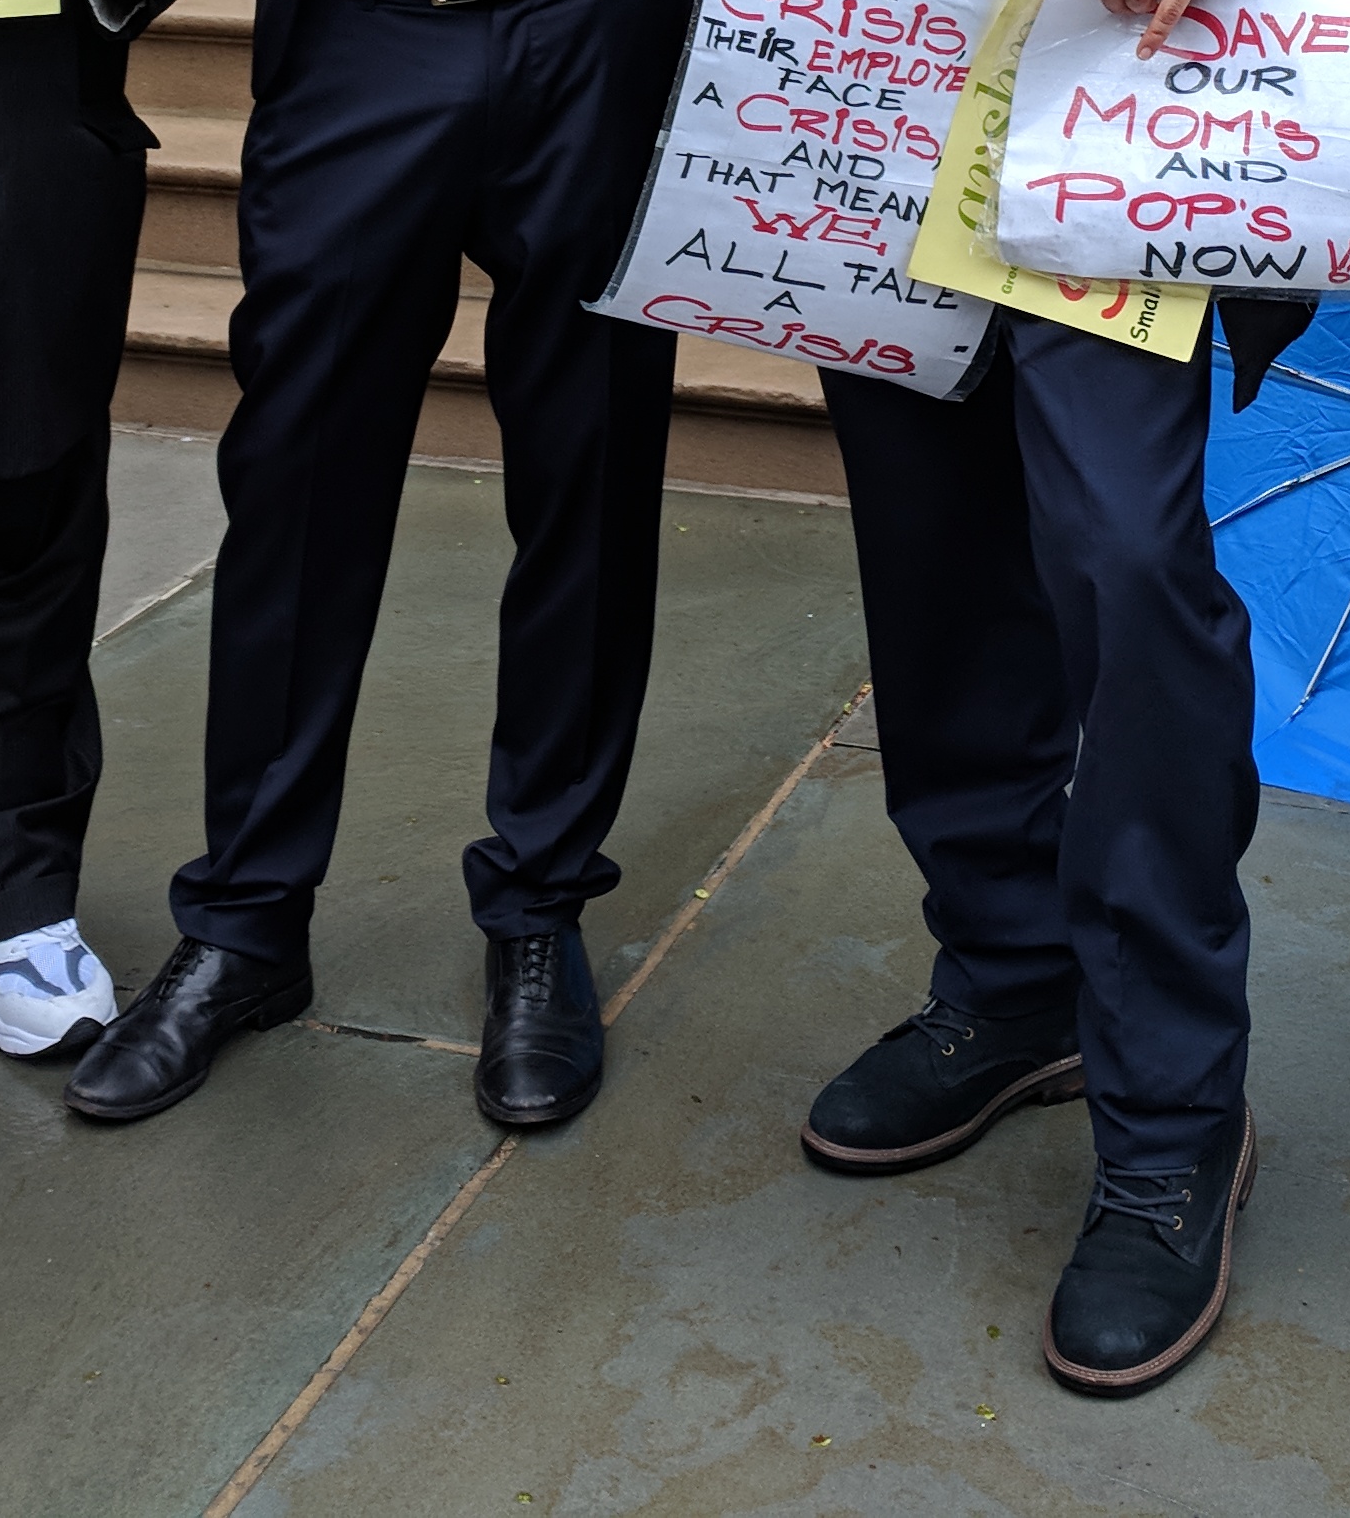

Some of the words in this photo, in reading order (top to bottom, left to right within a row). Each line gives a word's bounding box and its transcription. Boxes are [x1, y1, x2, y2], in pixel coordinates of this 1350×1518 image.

[703, 16, 800, 64] THEIR
[807, 41, 971, 94] EMPLOYE
[693, 82, 724, 109] A
[779, 68, 908, 111] FACE
[1164, 61, 1297, 97] OUR
[781, 142, 886, 181] AND
[1155, 151, 1288, 184] AND
[676, 153, 796, 194] THAT
[813, 177, 929, 226] MEAN
[733, 195, 887, 257] WE
[665, 228, 826, 291] ALL
[1139, 241, 1307, 280] NOW
[763, 290, 802, 315] A
